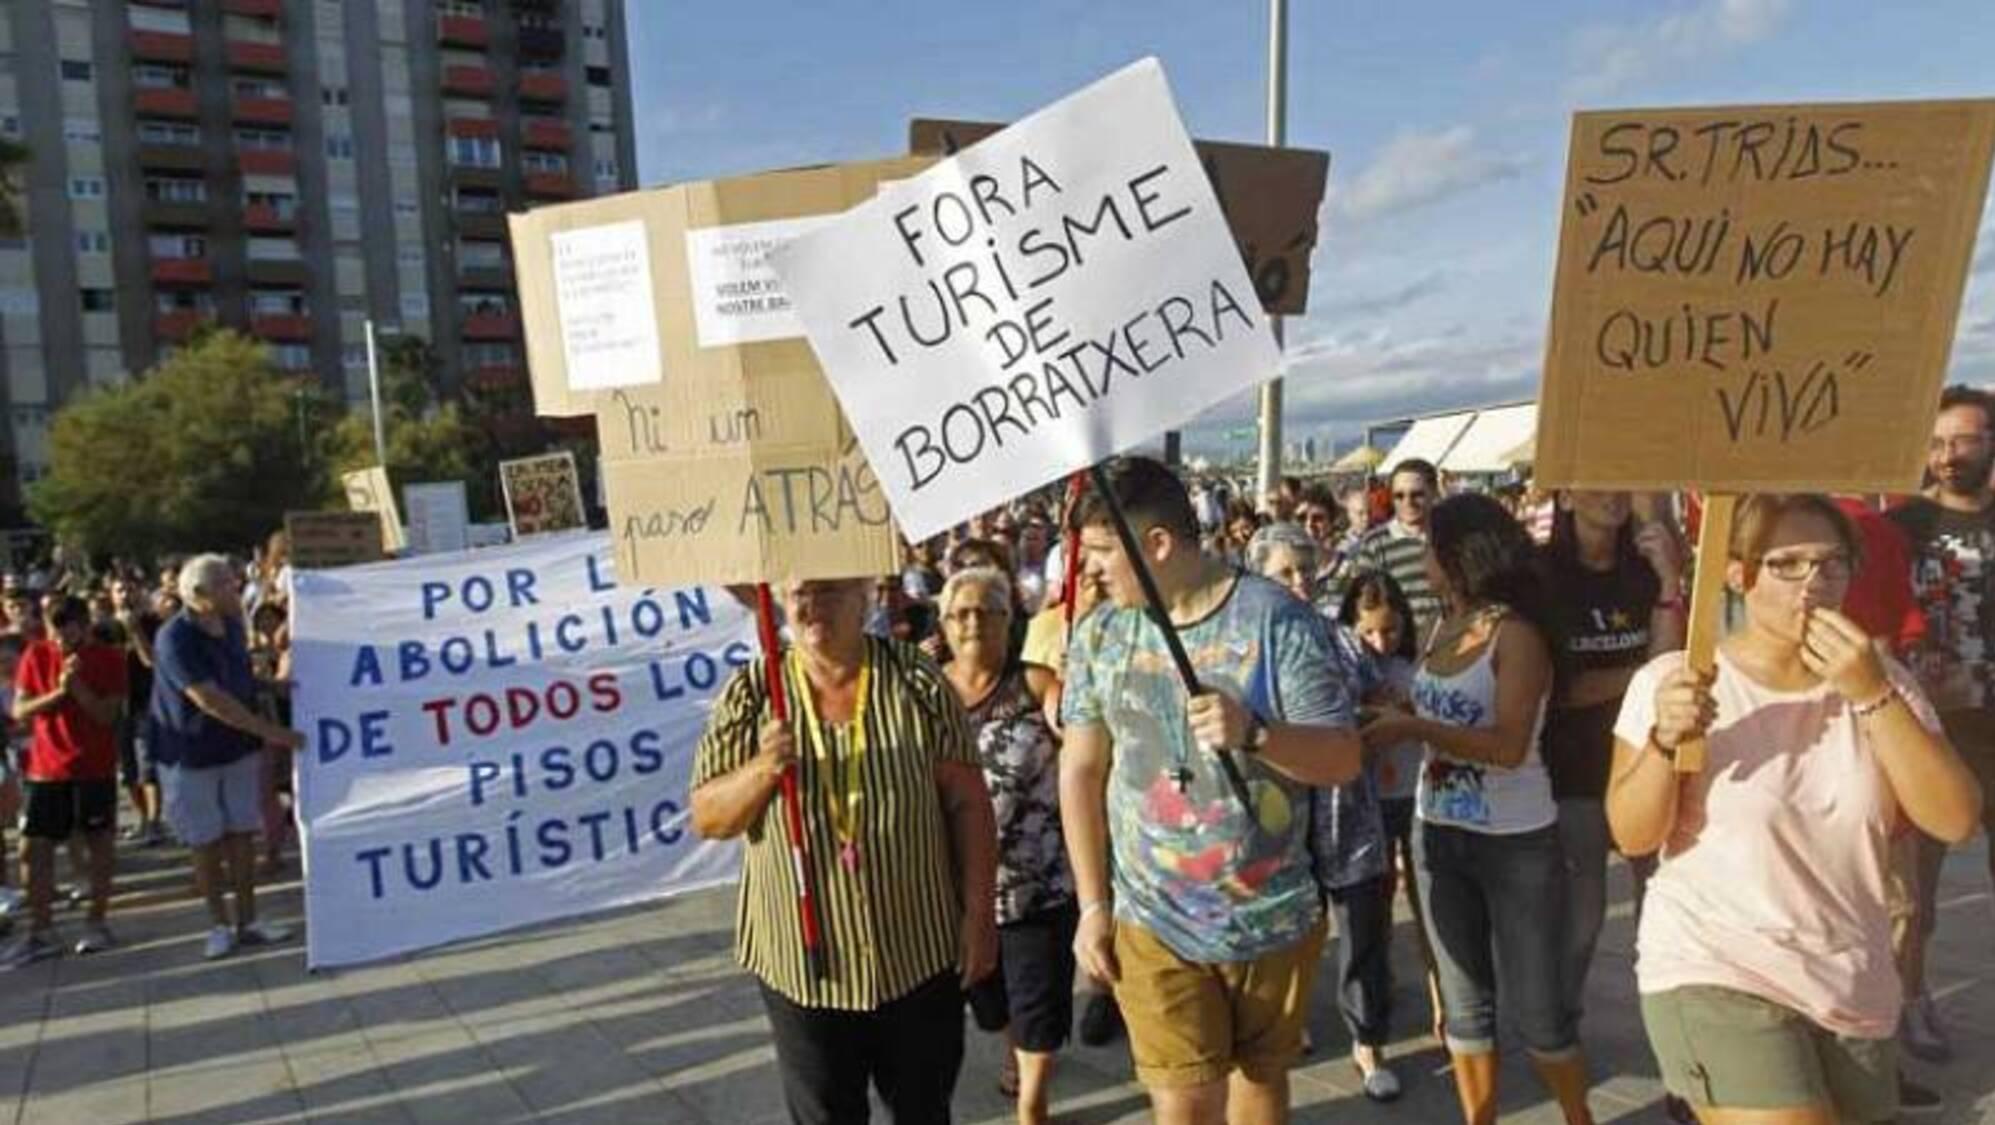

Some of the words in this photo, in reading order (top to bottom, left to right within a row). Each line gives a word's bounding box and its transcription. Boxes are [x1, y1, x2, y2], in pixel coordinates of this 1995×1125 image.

[1585, 122, 1686, 185] SR.
[893, 156, 1062, 267] FORA
[1736, 221, 1804, 285] NO
[1819, 222, 1914, 298] HAY
[985, 296, 1071, 371] DE
[893, 279, 1256, 491] BORRATXERA
[709, 406, 761, 444] un
[623, 499, 716, 580] paso
[422, 567, 540, 620] POR
[586, 554, 617, 592] L
[350, 586, 712, 687] ABOLICIÓN
[317, 709, 393, 764] DE
[422, 671, 622, 746] TODOS
[468, 729, 664, 806] PISOS
[356, 799, 684, 899] TURÍSTIC
